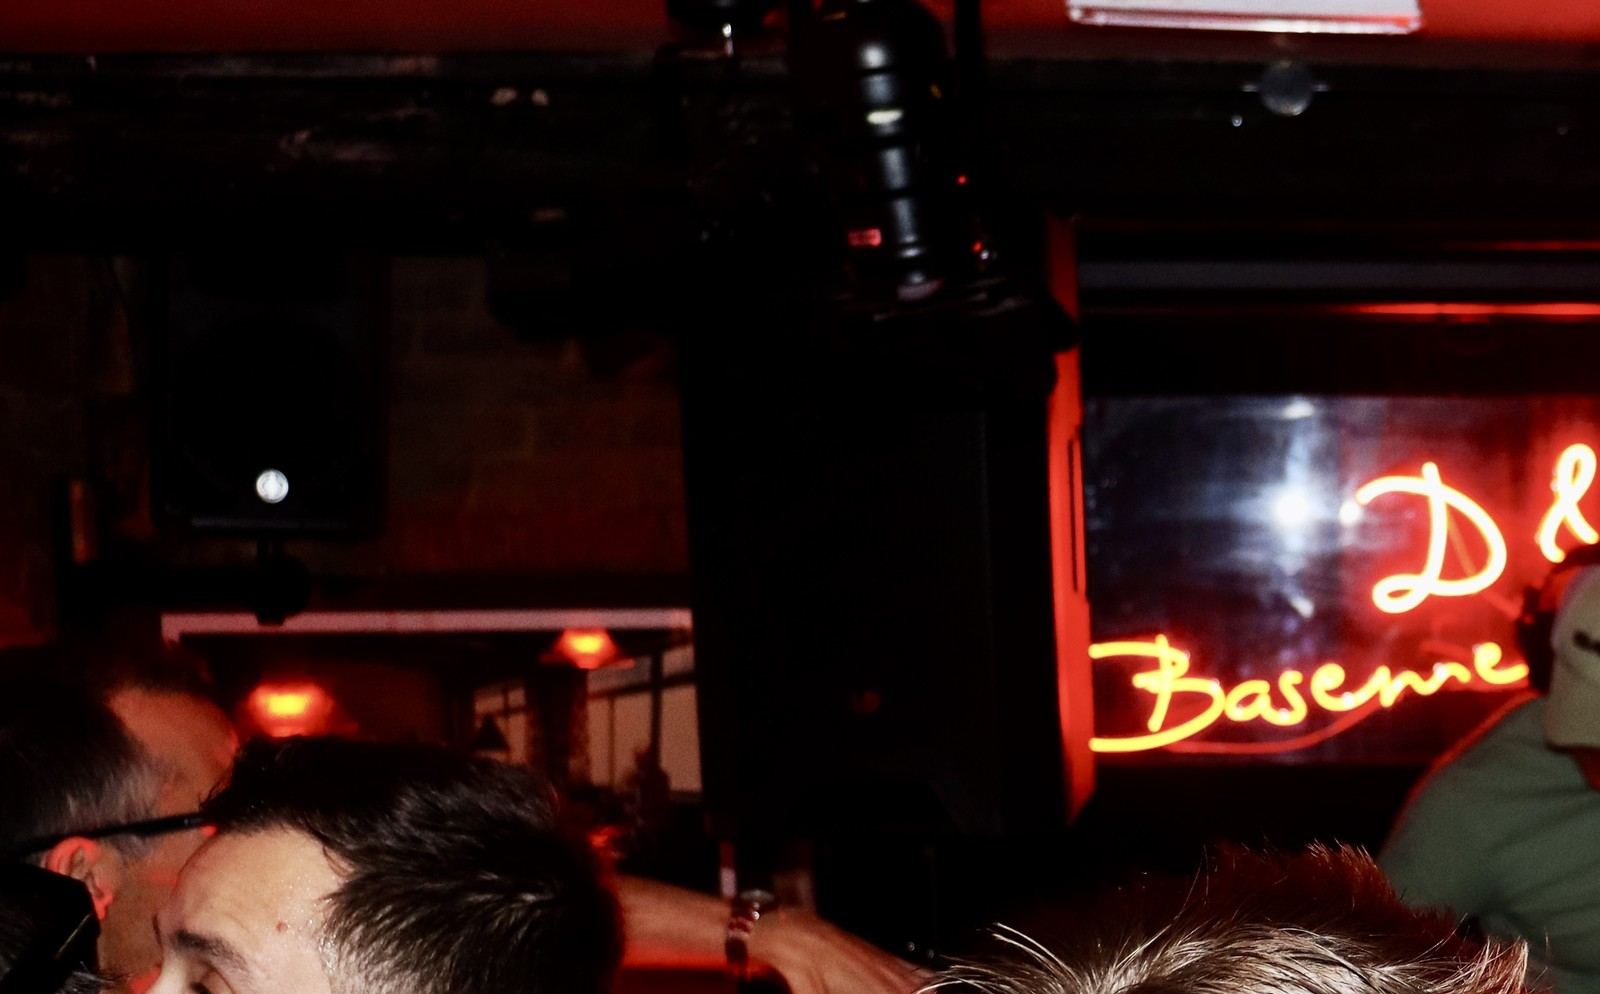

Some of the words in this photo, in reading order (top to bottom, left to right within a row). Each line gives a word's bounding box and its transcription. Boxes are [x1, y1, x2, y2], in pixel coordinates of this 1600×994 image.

[1355, 460, 1507, 614] D
[1535, 443, 1600, 563] &
[1088, 634, 1530, 753] Baseme
